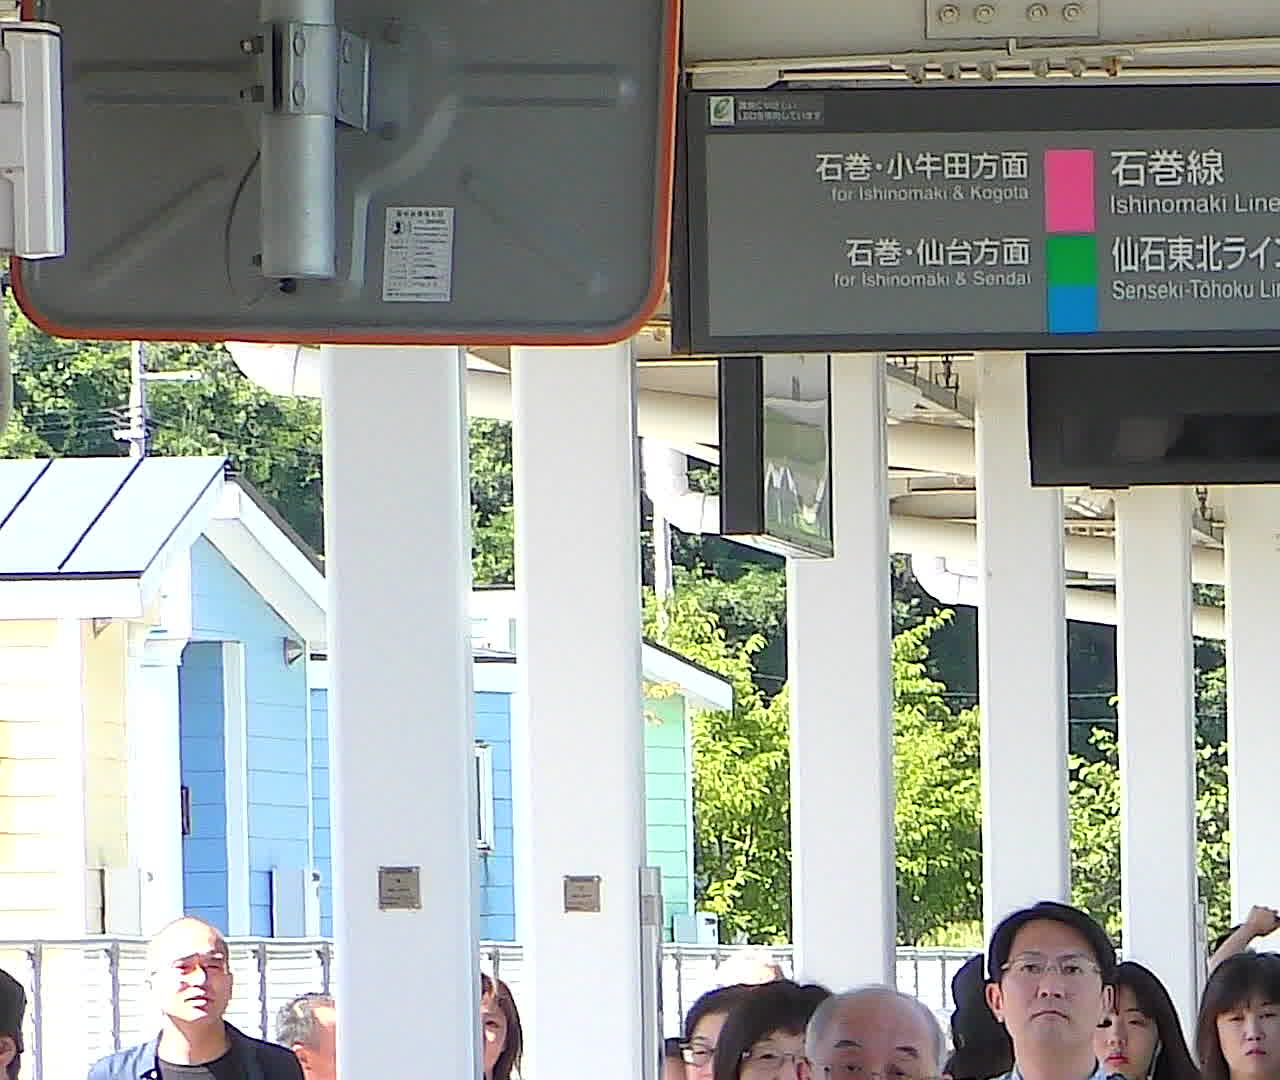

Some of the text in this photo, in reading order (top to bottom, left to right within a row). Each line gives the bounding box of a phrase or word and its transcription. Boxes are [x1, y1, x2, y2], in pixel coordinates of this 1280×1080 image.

[815, 151, 1029, 181] 石巻・小牛田方面
[1110, 149, 1225, 187] 石巻線
[832, 185, 1029, 204] for Ishinomaki & Kogota
[1110, 193, 1280, 215] Ishinomaki Line
[846, 237, 1031, 266] 石巻・仙台方面
[833, 270, 1032, 289] for Ishinomaki & Sendai
